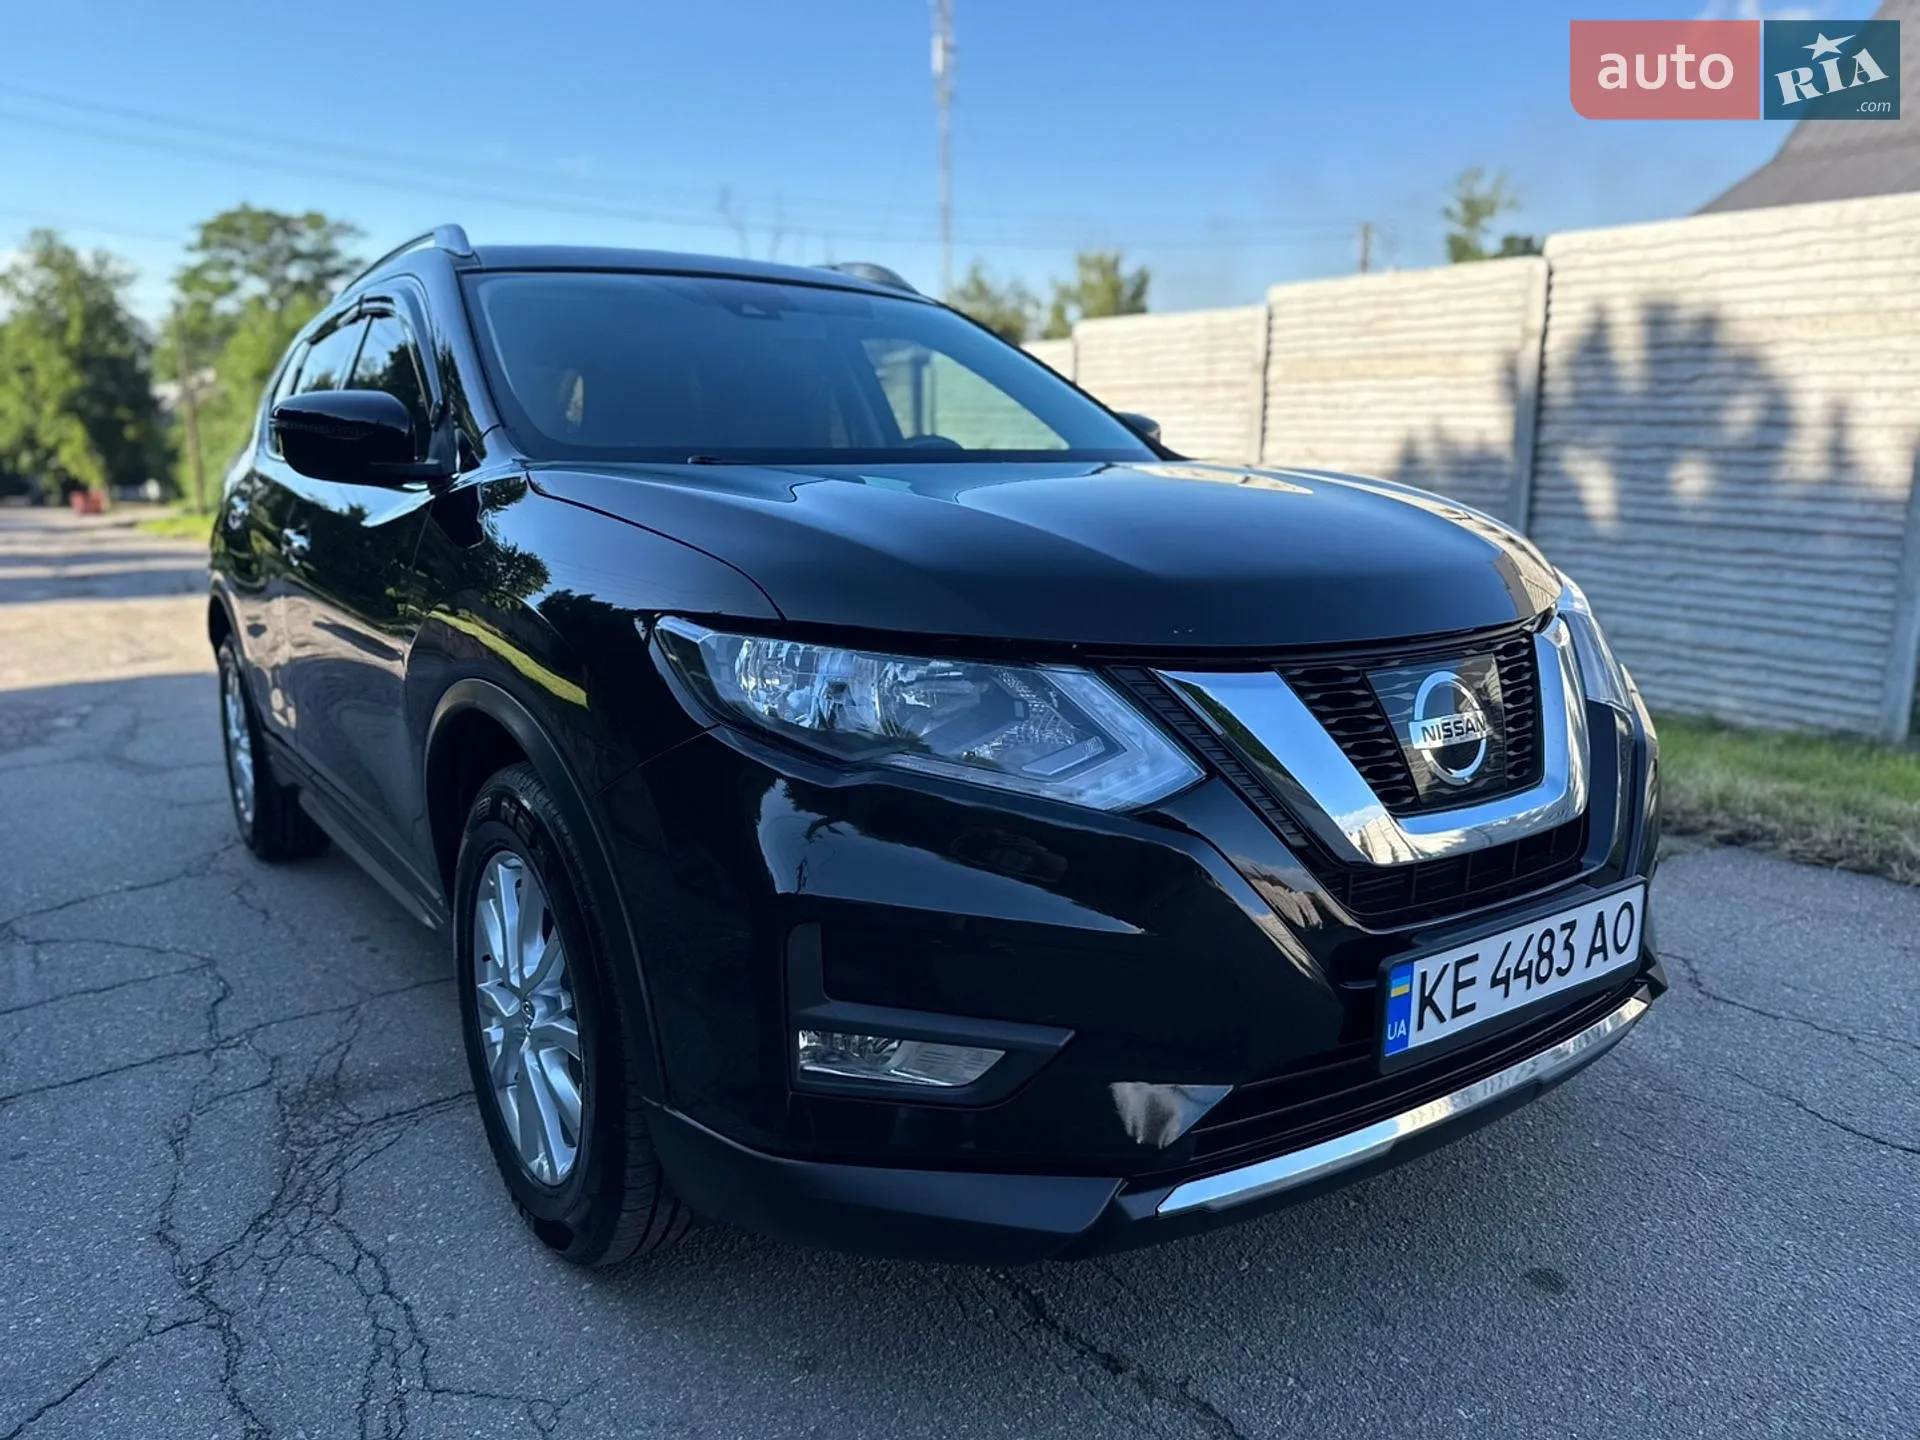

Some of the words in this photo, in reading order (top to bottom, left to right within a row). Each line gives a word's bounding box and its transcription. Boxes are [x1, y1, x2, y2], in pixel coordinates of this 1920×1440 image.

[1420, 715, 1486, 743] NISSAN
[1417, 953, 1479, 1032] KE
[1490, 919, 1577, 998] 4483
[1585, 901, 1636, 969] AO
[1387, 1019, 1408, 1040] UA
